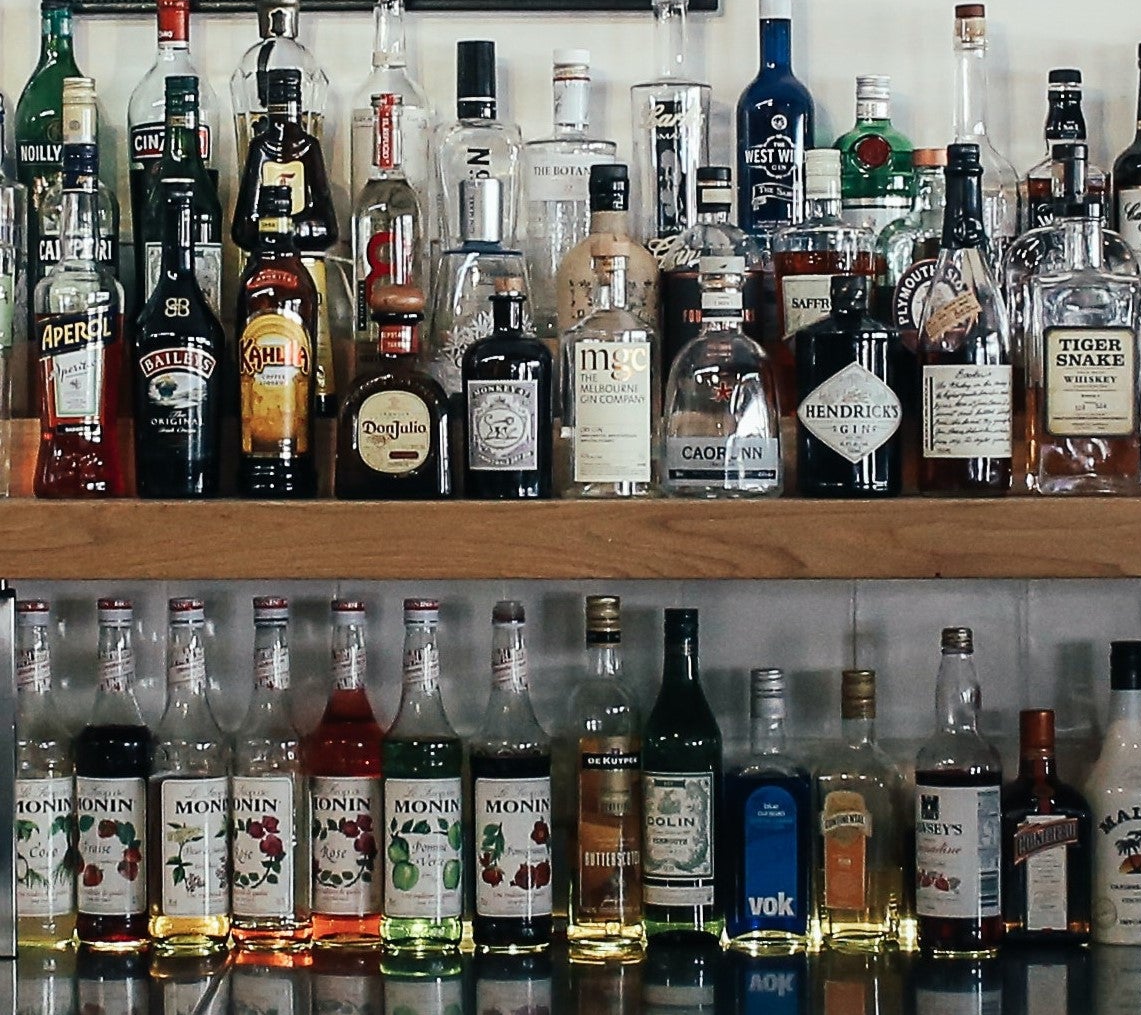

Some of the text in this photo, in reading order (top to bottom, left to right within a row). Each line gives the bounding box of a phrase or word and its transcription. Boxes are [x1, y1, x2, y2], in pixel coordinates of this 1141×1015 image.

[20, 144, 63, 163] NOILLY
[744, 149, 774, 164] WEST
[897, 263, 938, 325] PLYMOUTH
[42, 316, 112, 351] APEROL
[1058, 338, 1122, 352] TIGER
[580, 346, 648, 381] mgc
[1055, 353, 1125, 367] SNAKE
[580, 373, 597, 383] THE
[1063, 375, 1117, 384] WHISKEY
[580, 384, 639, 394] MELBOURNE
[580, 395, 646, 404] GIN COMPANY
[806, 404, 899, 418] HENDRICK'S
[394, 799, 460, 813] MONIN
[485, 799, 550, 813] MONIN
[320, 845, 347, 864] Rose
[748, 891, 795, 917] vok
